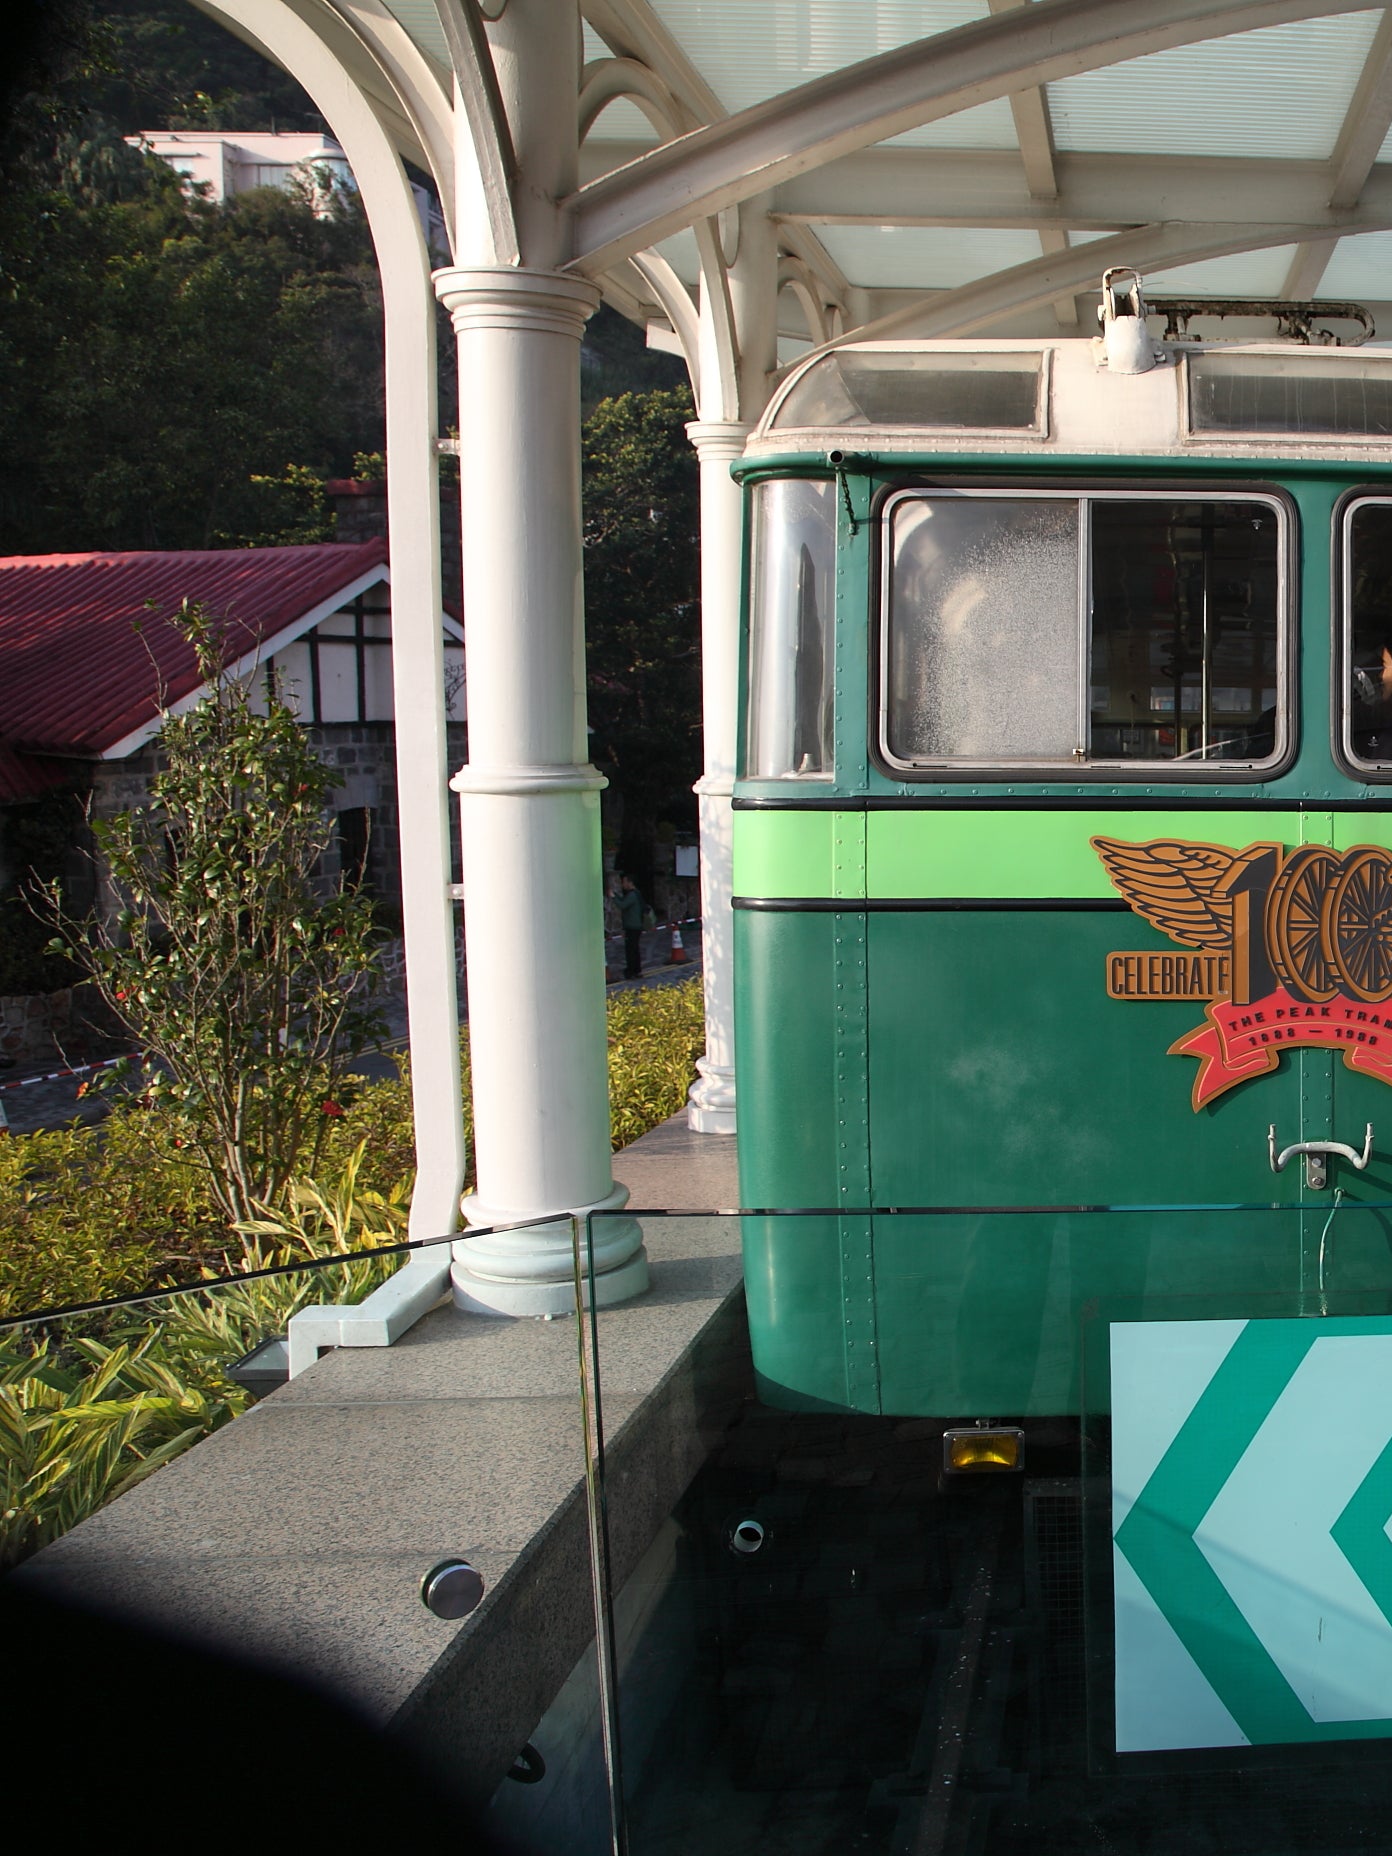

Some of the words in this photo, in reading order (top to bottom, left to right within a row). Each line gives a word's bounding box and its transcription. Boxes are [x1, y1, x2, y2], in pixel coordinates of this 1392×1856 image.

[1111, 955, 1230, 995] CELEBRATE
[1228, 1012, 1266, 1032] THE
[1276, 1007, 1332, 1019] PEAK
[1249, 1028, 1296, 1046] 1888
[1335, 1028, 1379, 1046] 1988
